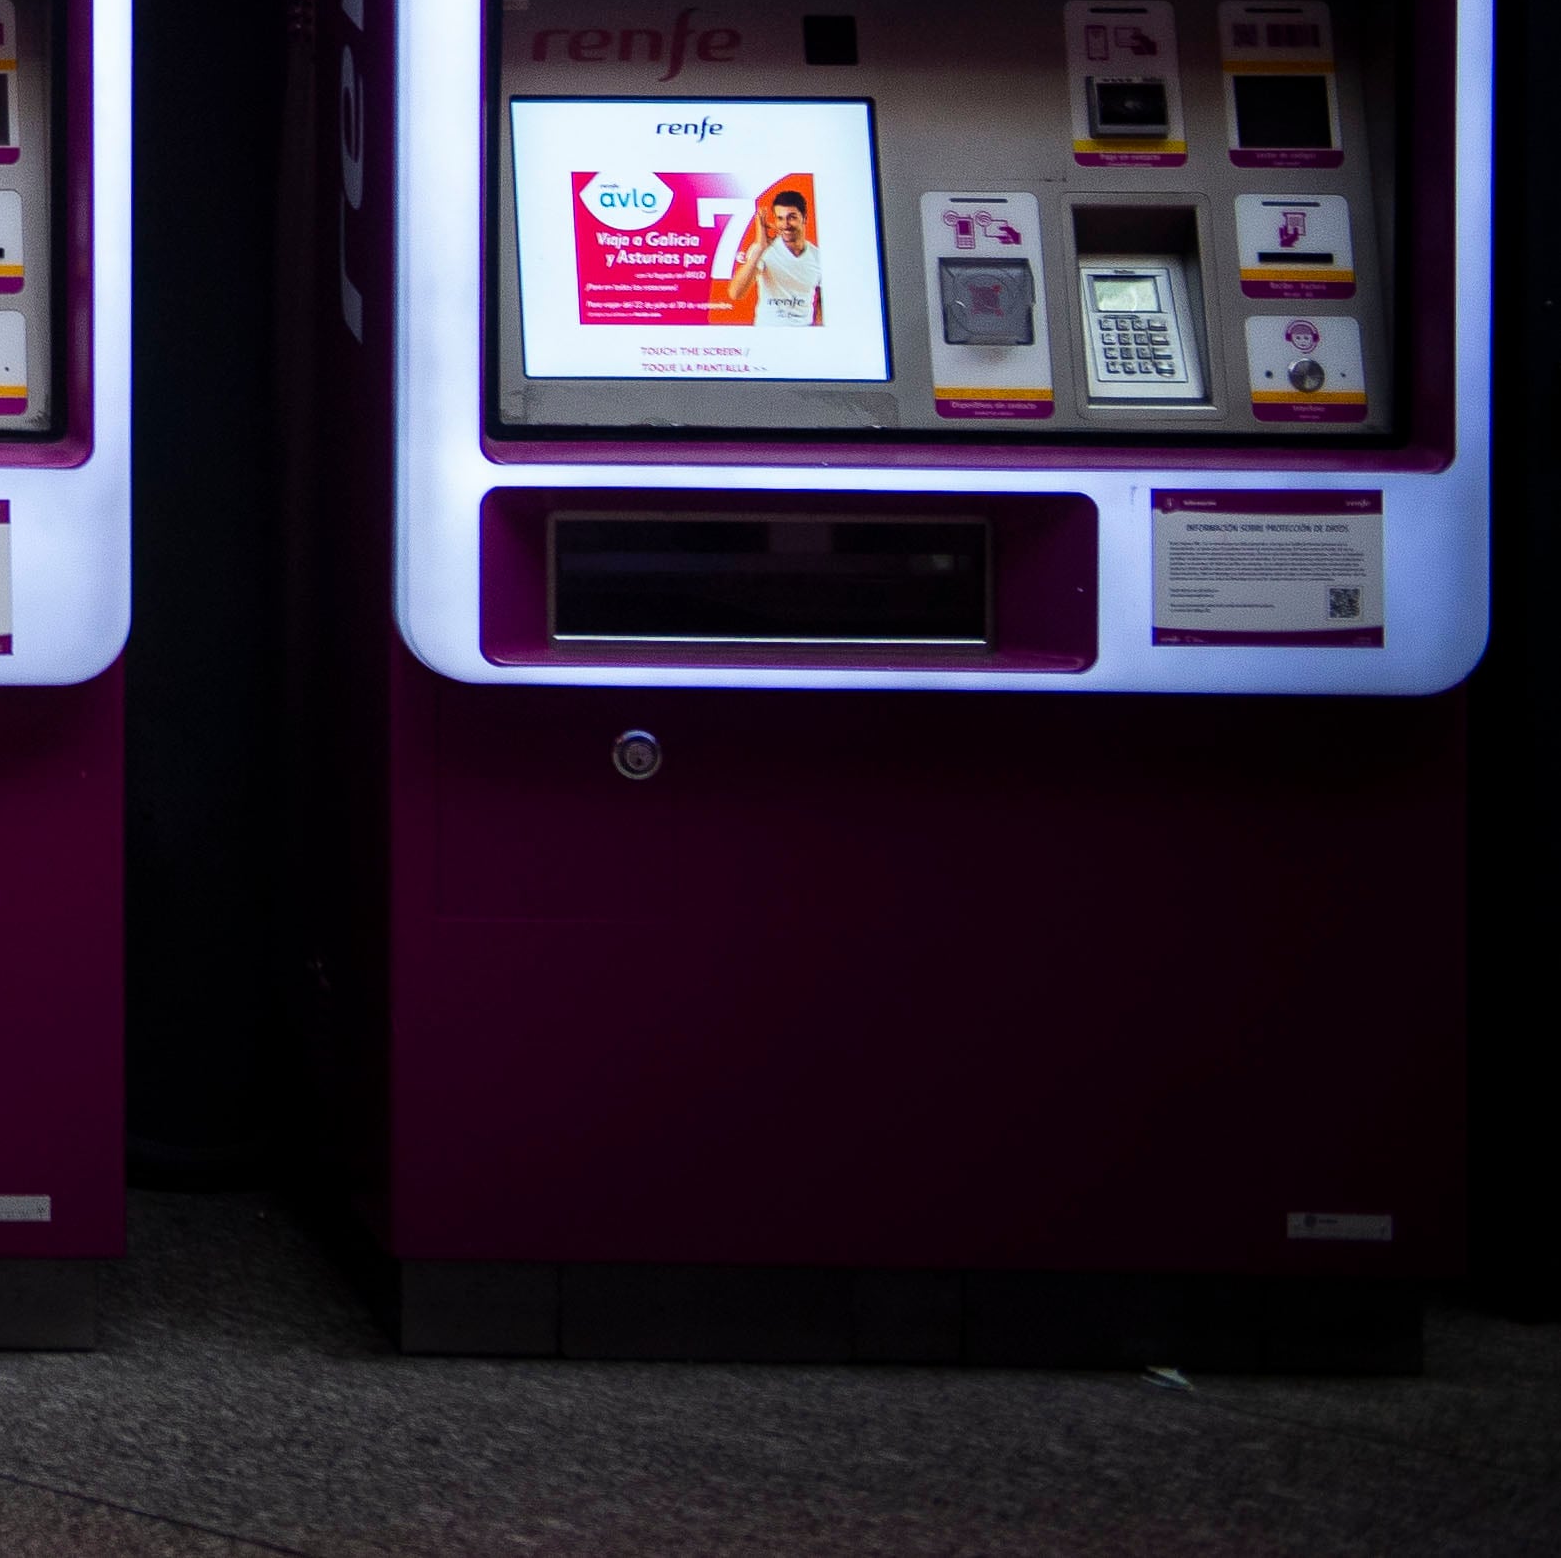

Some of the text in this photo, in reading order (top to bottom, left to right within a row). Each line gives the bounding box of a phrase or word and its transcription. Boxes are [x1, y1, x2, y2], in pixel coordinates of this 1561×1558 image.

[532, 7, 743, 83] renfe
[656, 115, 724, 143] renfe
[600, 188, 657, 209] avlo
[596, 232, 700, 249] Viaja a Galicia
[696, 197, 757, 280] 7
[605, 250, 707, 267] y Asturias por
[640, 347, 742, 356] TOUCH THE SCREEN
[642, 363, 750, 372] TOQUE LA PANTALLA
